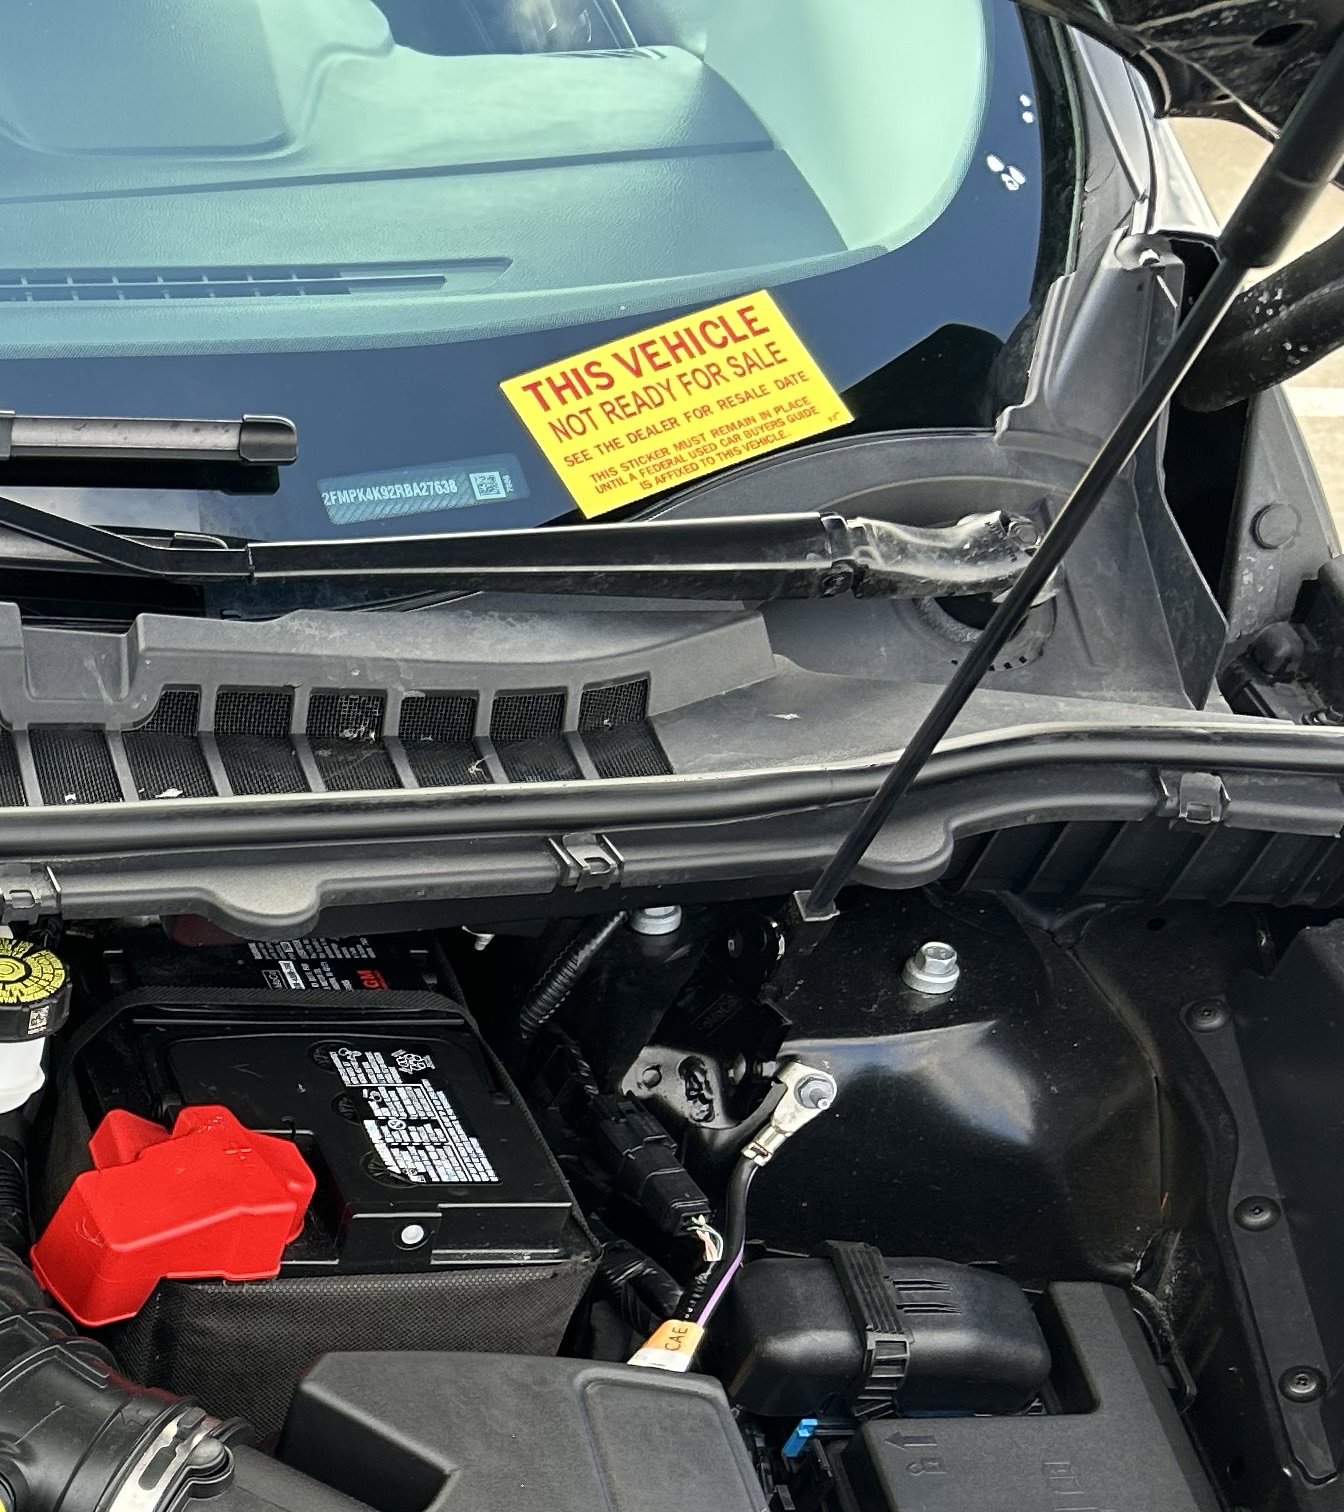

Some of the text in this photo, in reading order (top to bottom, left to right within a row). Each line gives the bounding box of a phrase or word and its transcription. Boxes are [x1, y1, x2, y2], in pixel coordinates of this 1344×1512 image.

[521, 305, 770, 412] THIS VEHICLE
[548, 341, 788, 443] NOT READY FOR SALE
[564, 371, 810, 467] SEE THE DEALER FOR RESALE DATE
[590, 396, 811, 483] THIS STICKER MUST REMAIN IN PLACE
[595, 477, 628, 494] UNTIL
[629, 473, 638, 482] A
[639, 454, 688, 478] FEDERAL
[688, 443, 717, 459] USED
[720, 433, 741, 448] CAR
[743, 418, 786, 439] BUYERS
[786, 406, 821, 423] GUIDE
[321, 479, 458, 506] 2FMPK4K92RBA27638
[640, 480, 653, 490] IS
[655, 462, 700, 486] AFFIXED
[700, 455, 716, 467] TO
[716, 446, 743, 462] THIS
[665, 1327, 688, 1351] CAE
